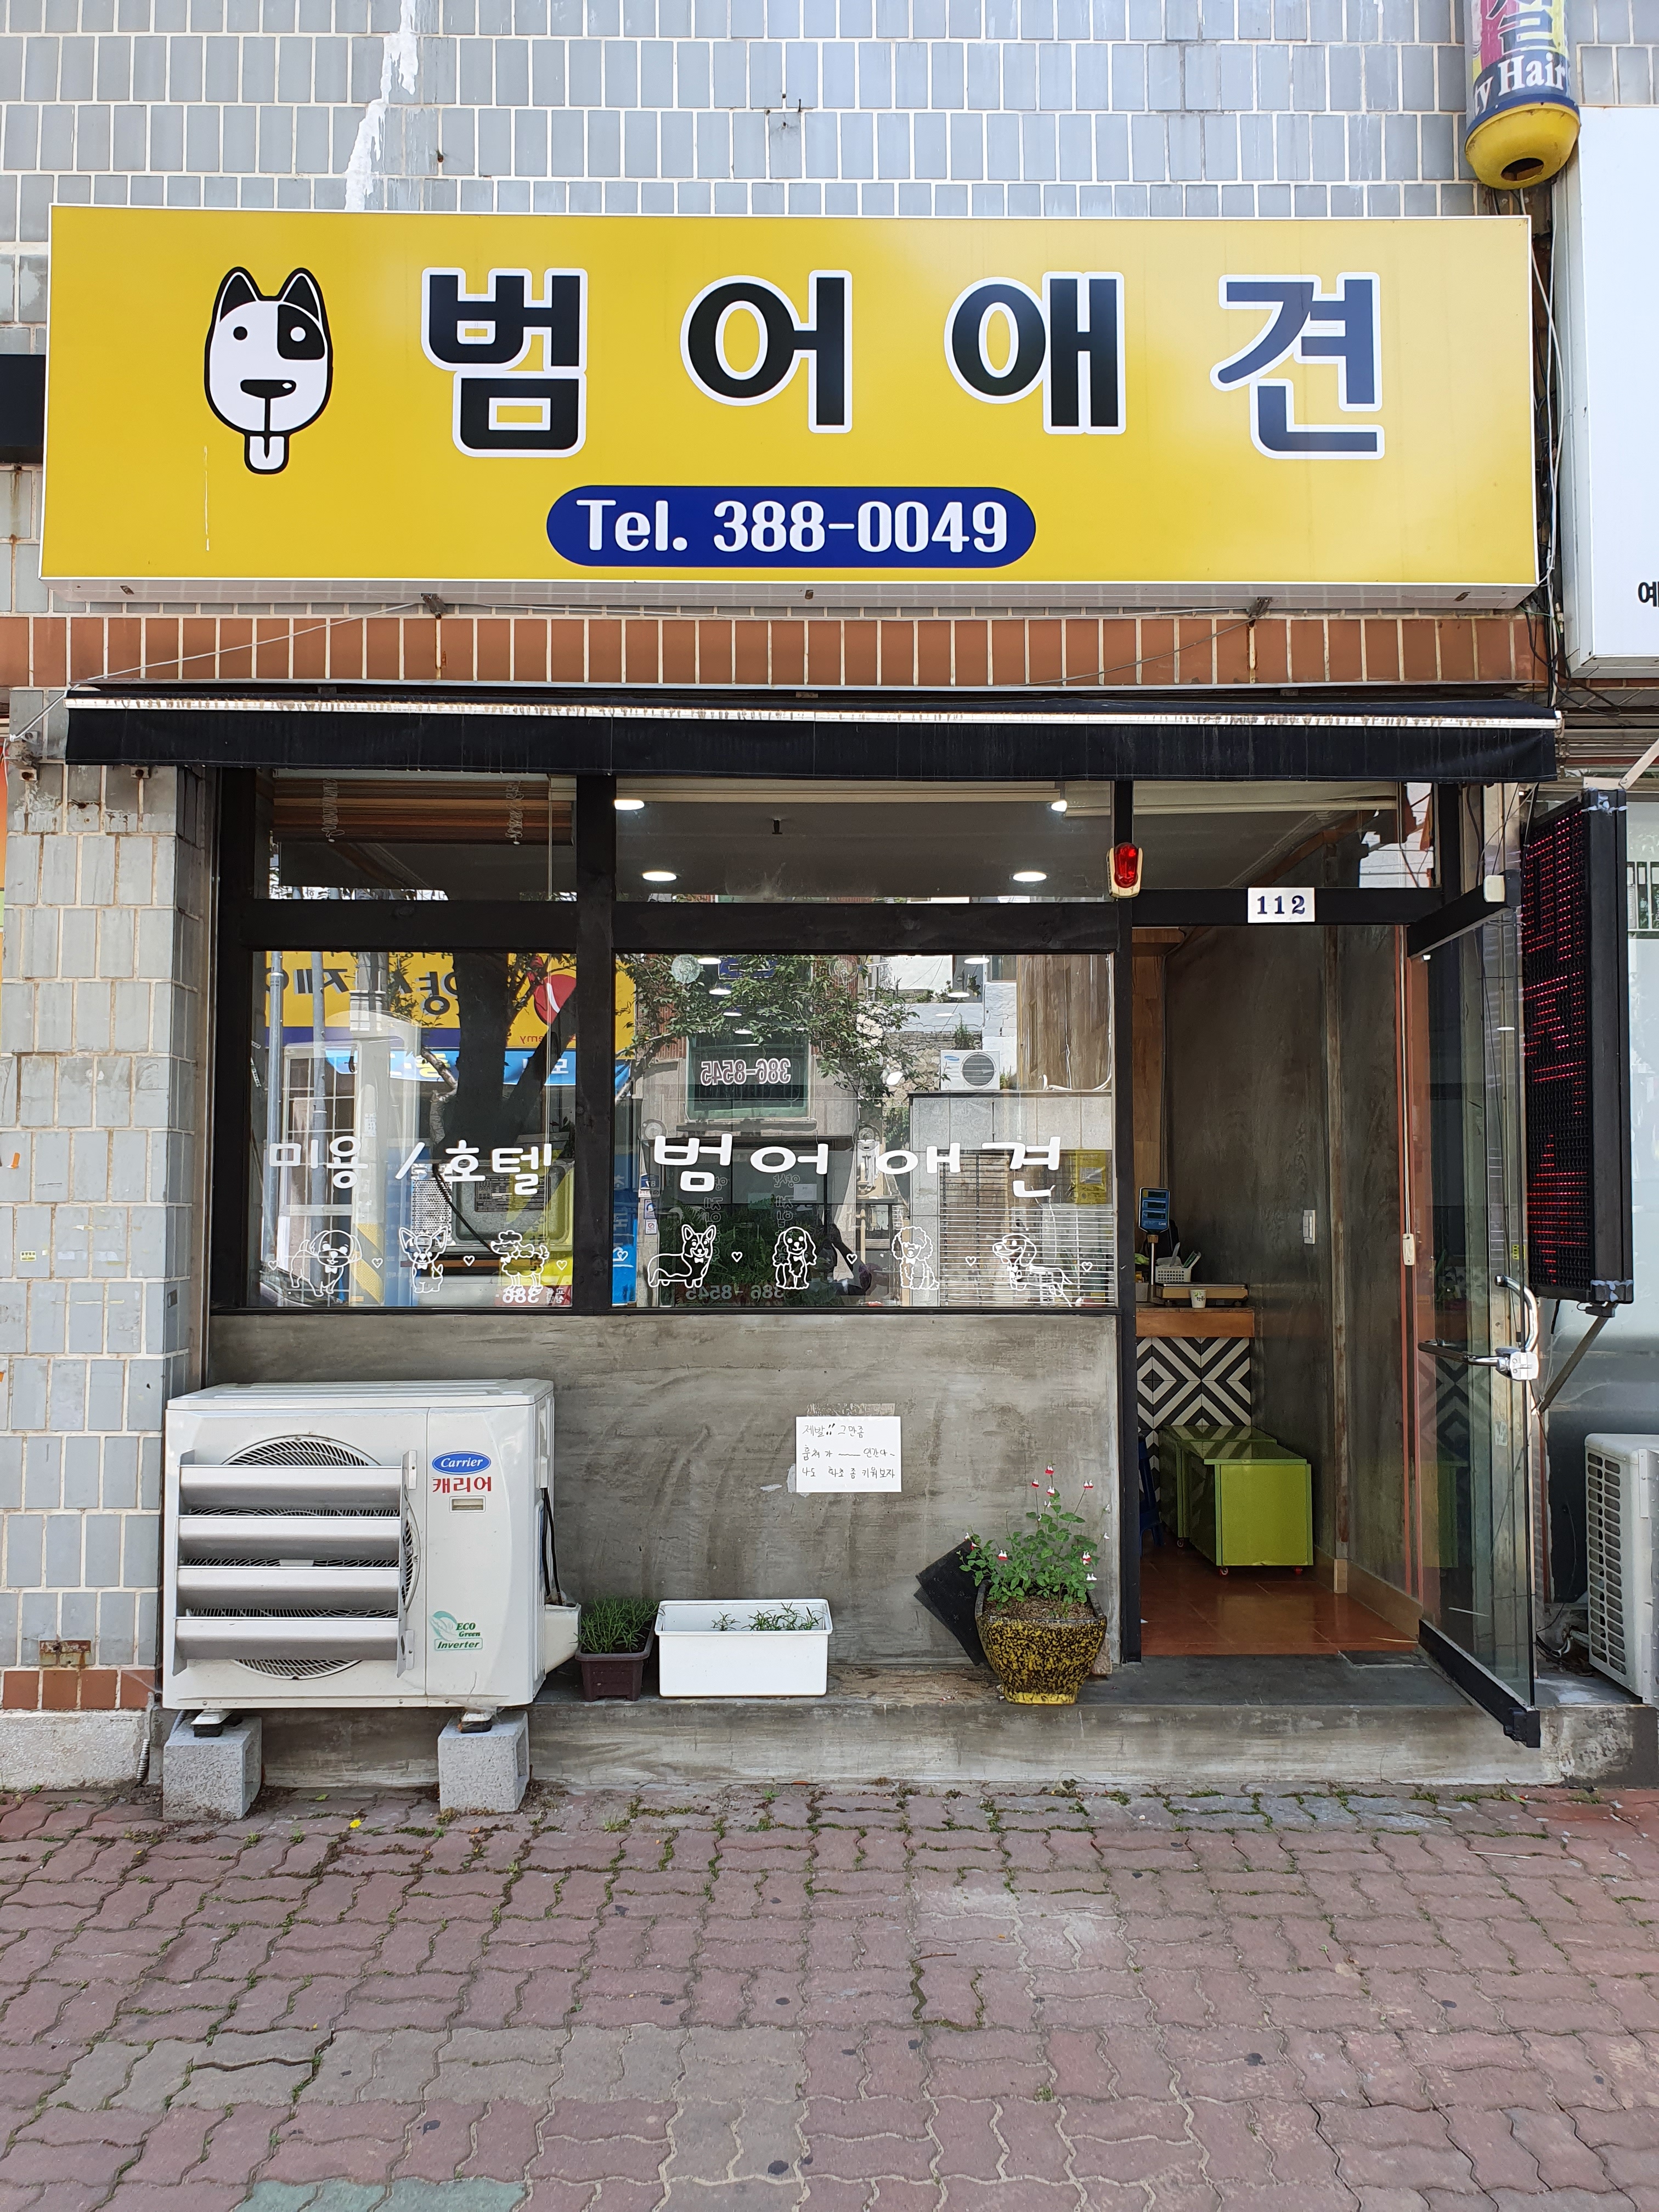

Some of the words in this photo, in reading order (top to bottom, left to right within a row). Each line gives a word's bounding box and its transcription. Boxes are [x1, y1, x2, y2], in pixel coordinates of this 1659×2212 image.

[1498, 52, 1565, 97] Hair
[576, 499, 687, 554] Tel.
[712, 499, 1009, 555] 388-0049
[1256, 894, 1306, 915] 112
[269, 1135, 368, 1189] 미용
[443, 1139, 552, 1195] 호텔
[802, 1423, 836, 1437] 제발!!
[439, 1456, 484, 1469] Carrier
[802, 1466, 816, 1477] 나도
[828, 1466, 844, 1477] 화초
[432, 1475, 492, 1494] 캐리어
[456, 1622, 476, 1632] ECO
[459, 1630, 481, 1638] Green
[437, 1640, 481, 1650] Inverter
